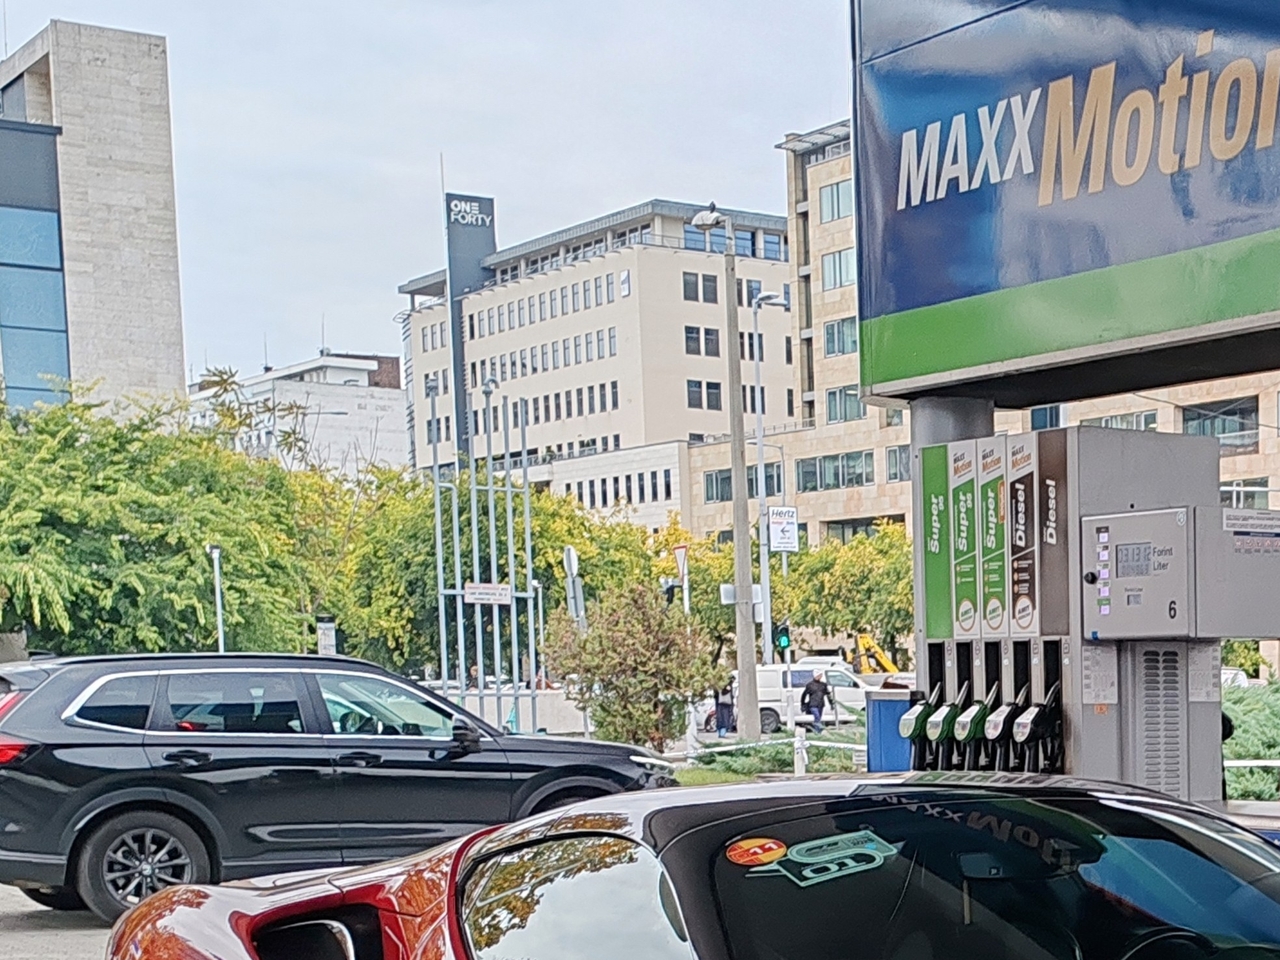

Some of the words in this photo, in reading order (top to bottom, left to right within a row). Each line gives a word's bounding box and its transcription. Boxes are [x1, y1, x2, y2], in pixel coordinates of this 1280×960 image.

[450, 199, 480, 214] ONE
[450, 211, 492, 227] FORTY
[771, 508, 796, 518] Hertz
[958, 491, 969, 552] Super
[986, 488, 997, 549] Super
[1015, 482, 1026, 548] Diesel
[1045, 479, 1057, 545] Diesel
[930, 493, 941, 554] Super
[1152, 545, 1174, 557] Forint
[1153, 560, 1169, 571] Liter
[1168, 600, 1177, 619] 6
